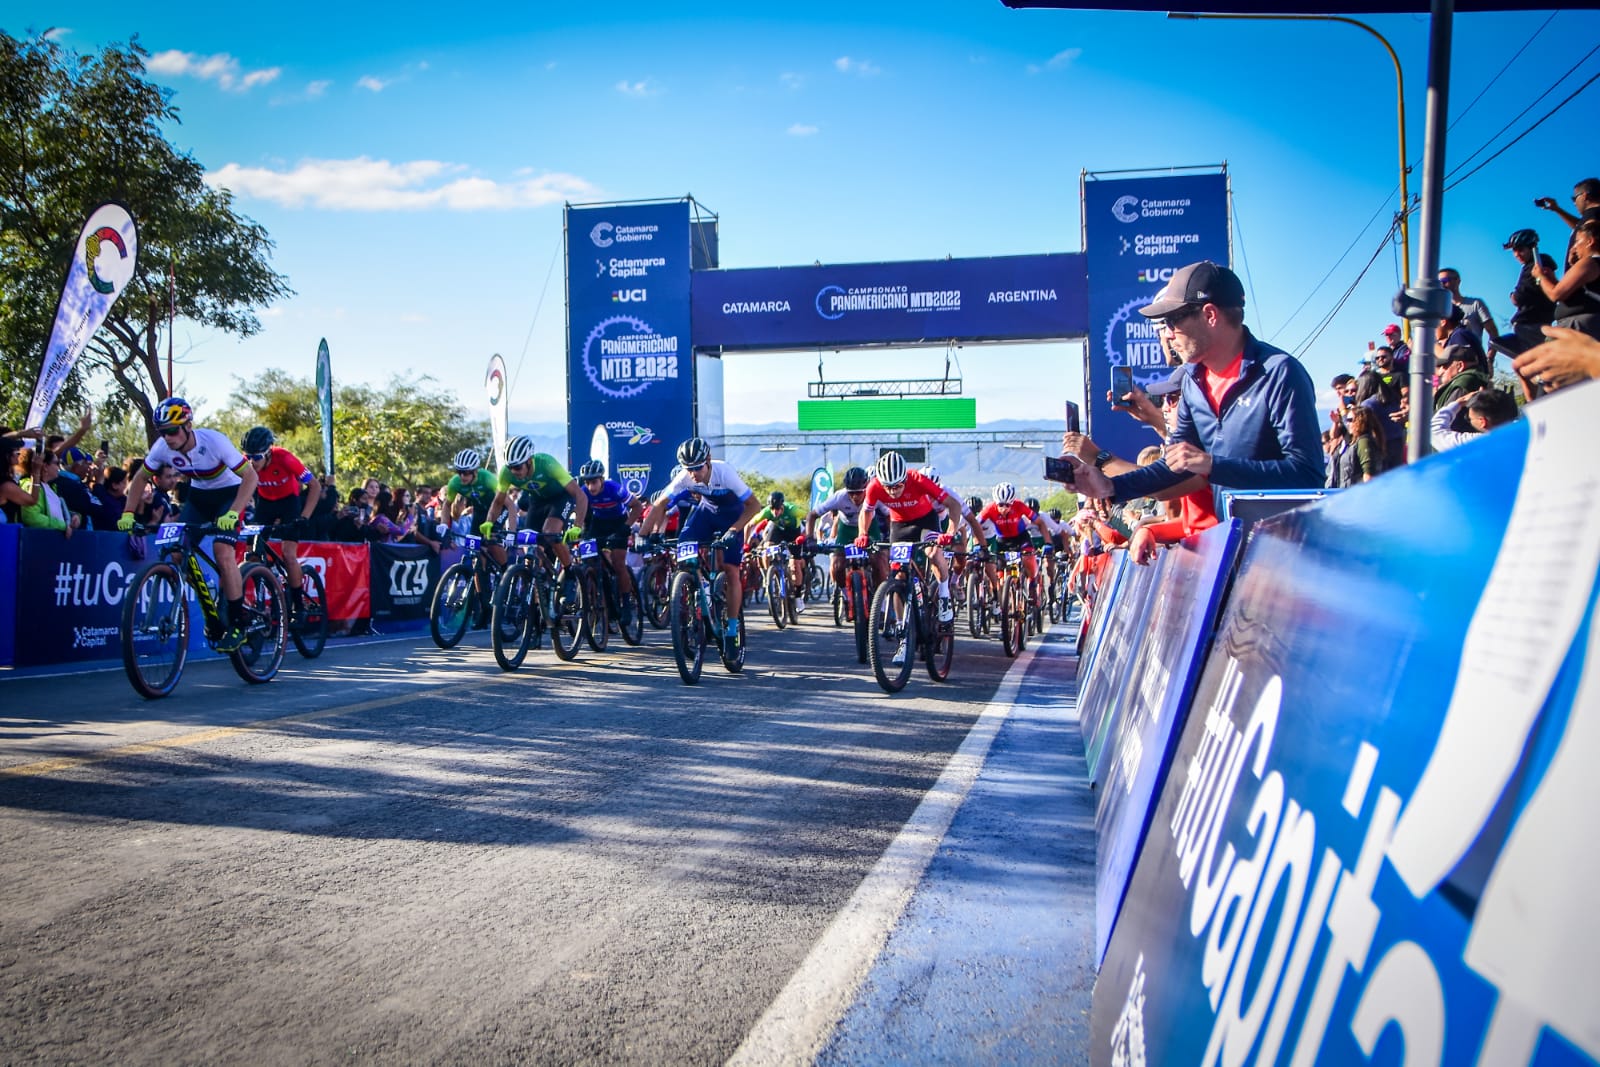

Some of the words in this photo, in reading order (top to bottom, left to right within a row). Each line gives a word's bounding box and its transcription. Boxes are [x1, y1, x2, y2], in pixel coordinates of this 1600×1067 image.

[1141, 198, 1191, 208] Catamarca
[1141, 207, 1184, 217] Gobierno
[615, 225, 659, 234] Catamarca
[615, 233, 653, 242] Gobierno
[1134, 234, 1199, 245] Catamarca
[609, 257, 666, 268] Catamarca
[618, 289, 647, 302] UCI
[848, 286, 908, 295] CAMPEONATO
[987, 288, 1058, 304] ARGENTINA
[722, 300, 791, 314] CATAMARCA
[831, 293, 909, 311] PANAMERICANO
[601, 336, 678, 354] PANAMERICANO
[1126, 342, 1162, 367] MTB
[601, 358, 632, 381] MTB
[635, 356, 679, 378] 2022
[605, 421, 635, 429] COPACI
[622, 470, 647, 479] UCRA
[162, 526, 178, 539] 18
[524, 532, 532, 543] 7
[469, 539, 476, 550] 8
[585, 543, 592, 554] 2
[850, 547, 859, 555] 11
[894, 546, 908, 559] 29
[81, 626, 119, 637] Catamarca
[81, 636, 107, 648] Capital
